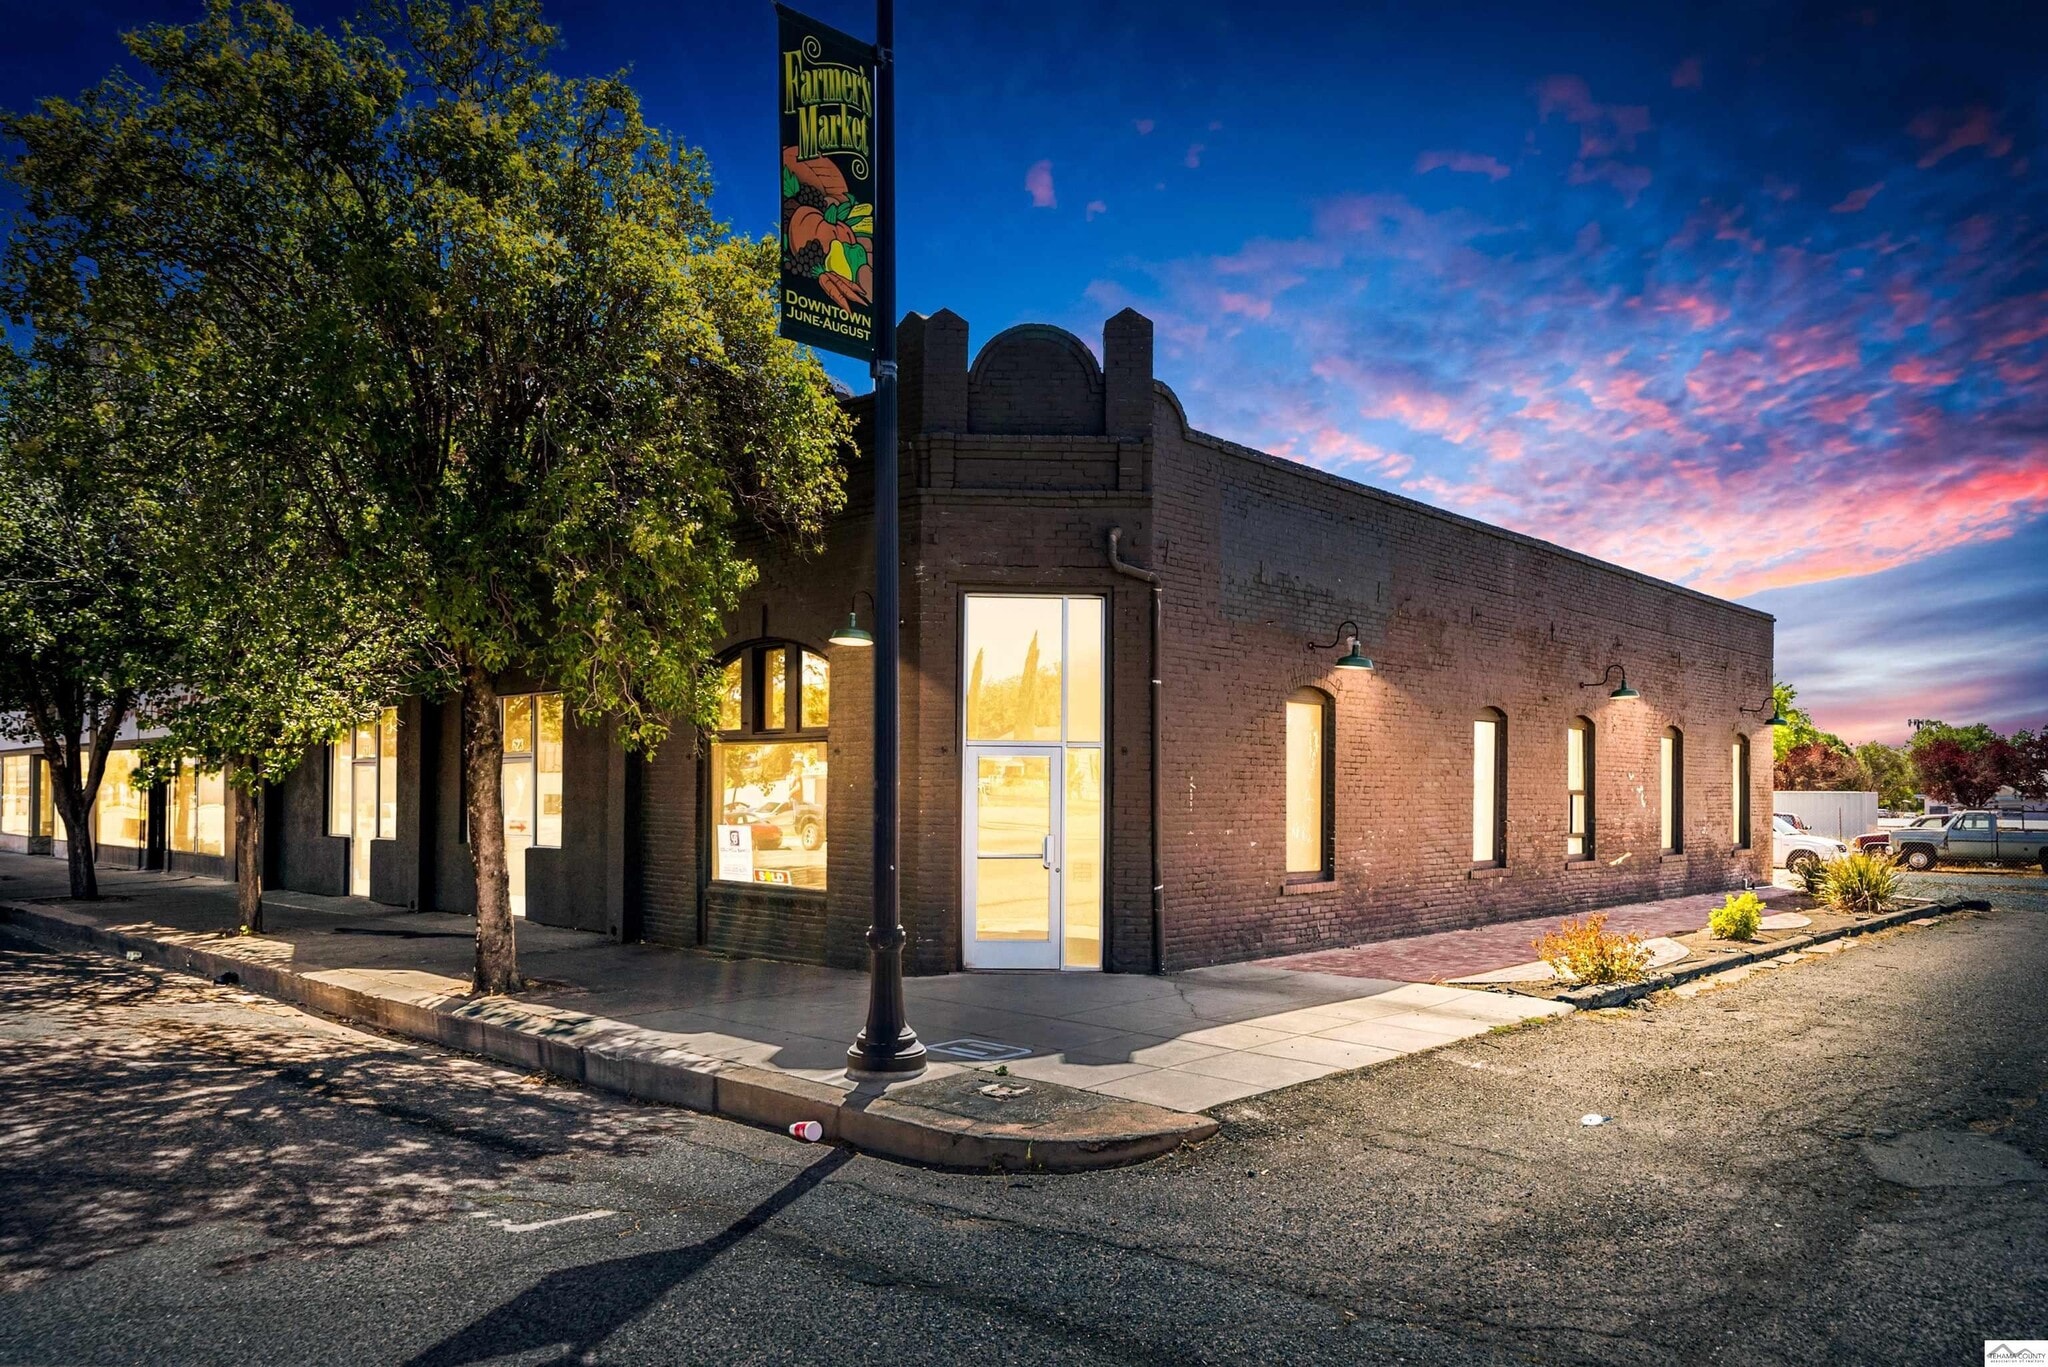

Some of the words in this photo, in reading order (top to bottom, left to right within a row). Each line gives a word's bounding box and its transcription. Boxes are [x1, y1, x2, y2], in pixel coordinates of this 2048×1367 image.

[783, 50, 872, 118] Farmer's
[797, 103, 870, 160] Market
[786, 289, 871, 328] DOWNTOWN
[786, 306, 871, 341] JUNE-AUGUST
